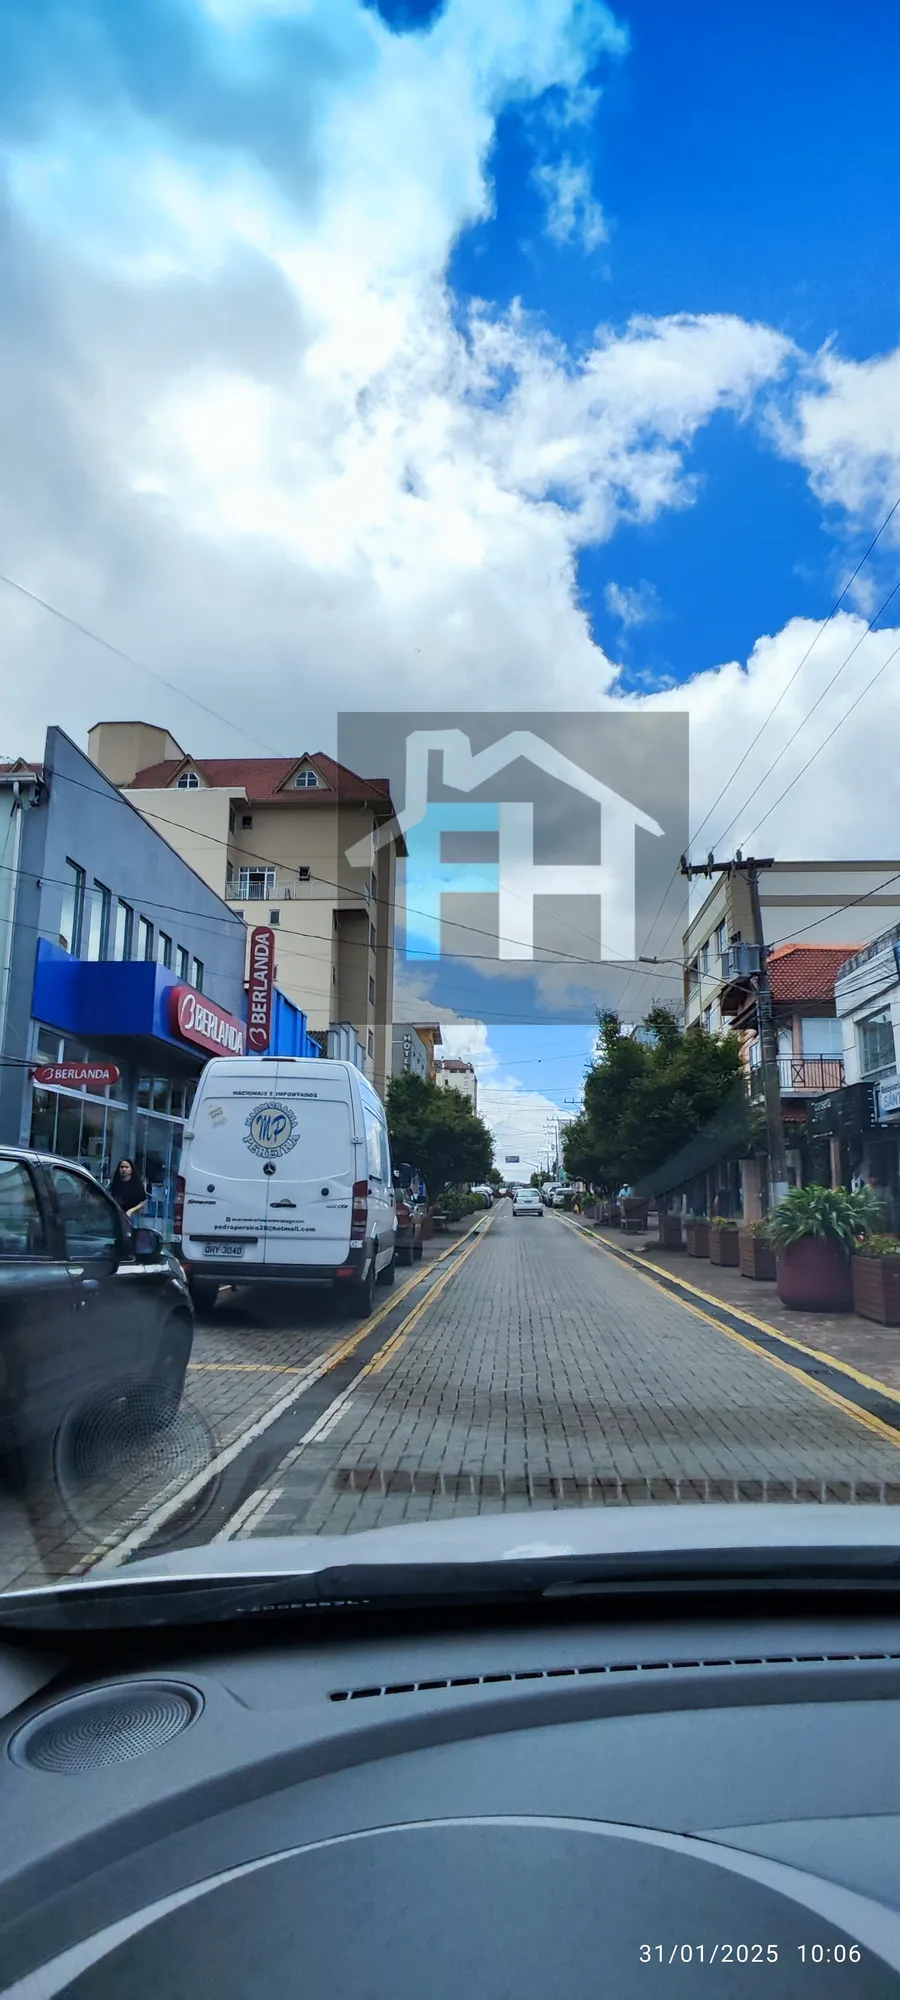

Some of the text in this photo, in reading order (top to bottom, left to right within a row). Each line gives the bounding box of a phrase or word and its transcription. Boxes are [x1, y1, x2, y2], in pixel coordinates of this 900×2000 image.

[251, 933, 270, 1024] BERLANDA
[195, 1003, 243, 1054] BERLANDA
[403, 1034, 411, 1071] HOTEL
[54, 1069, 110, 1079] BERLANDA
[244, 1101, 299, 1129] MARMORARIA
[256, 1114, 287, 1142] MP
[242, 1134, 300, 1159] PEREIRA
